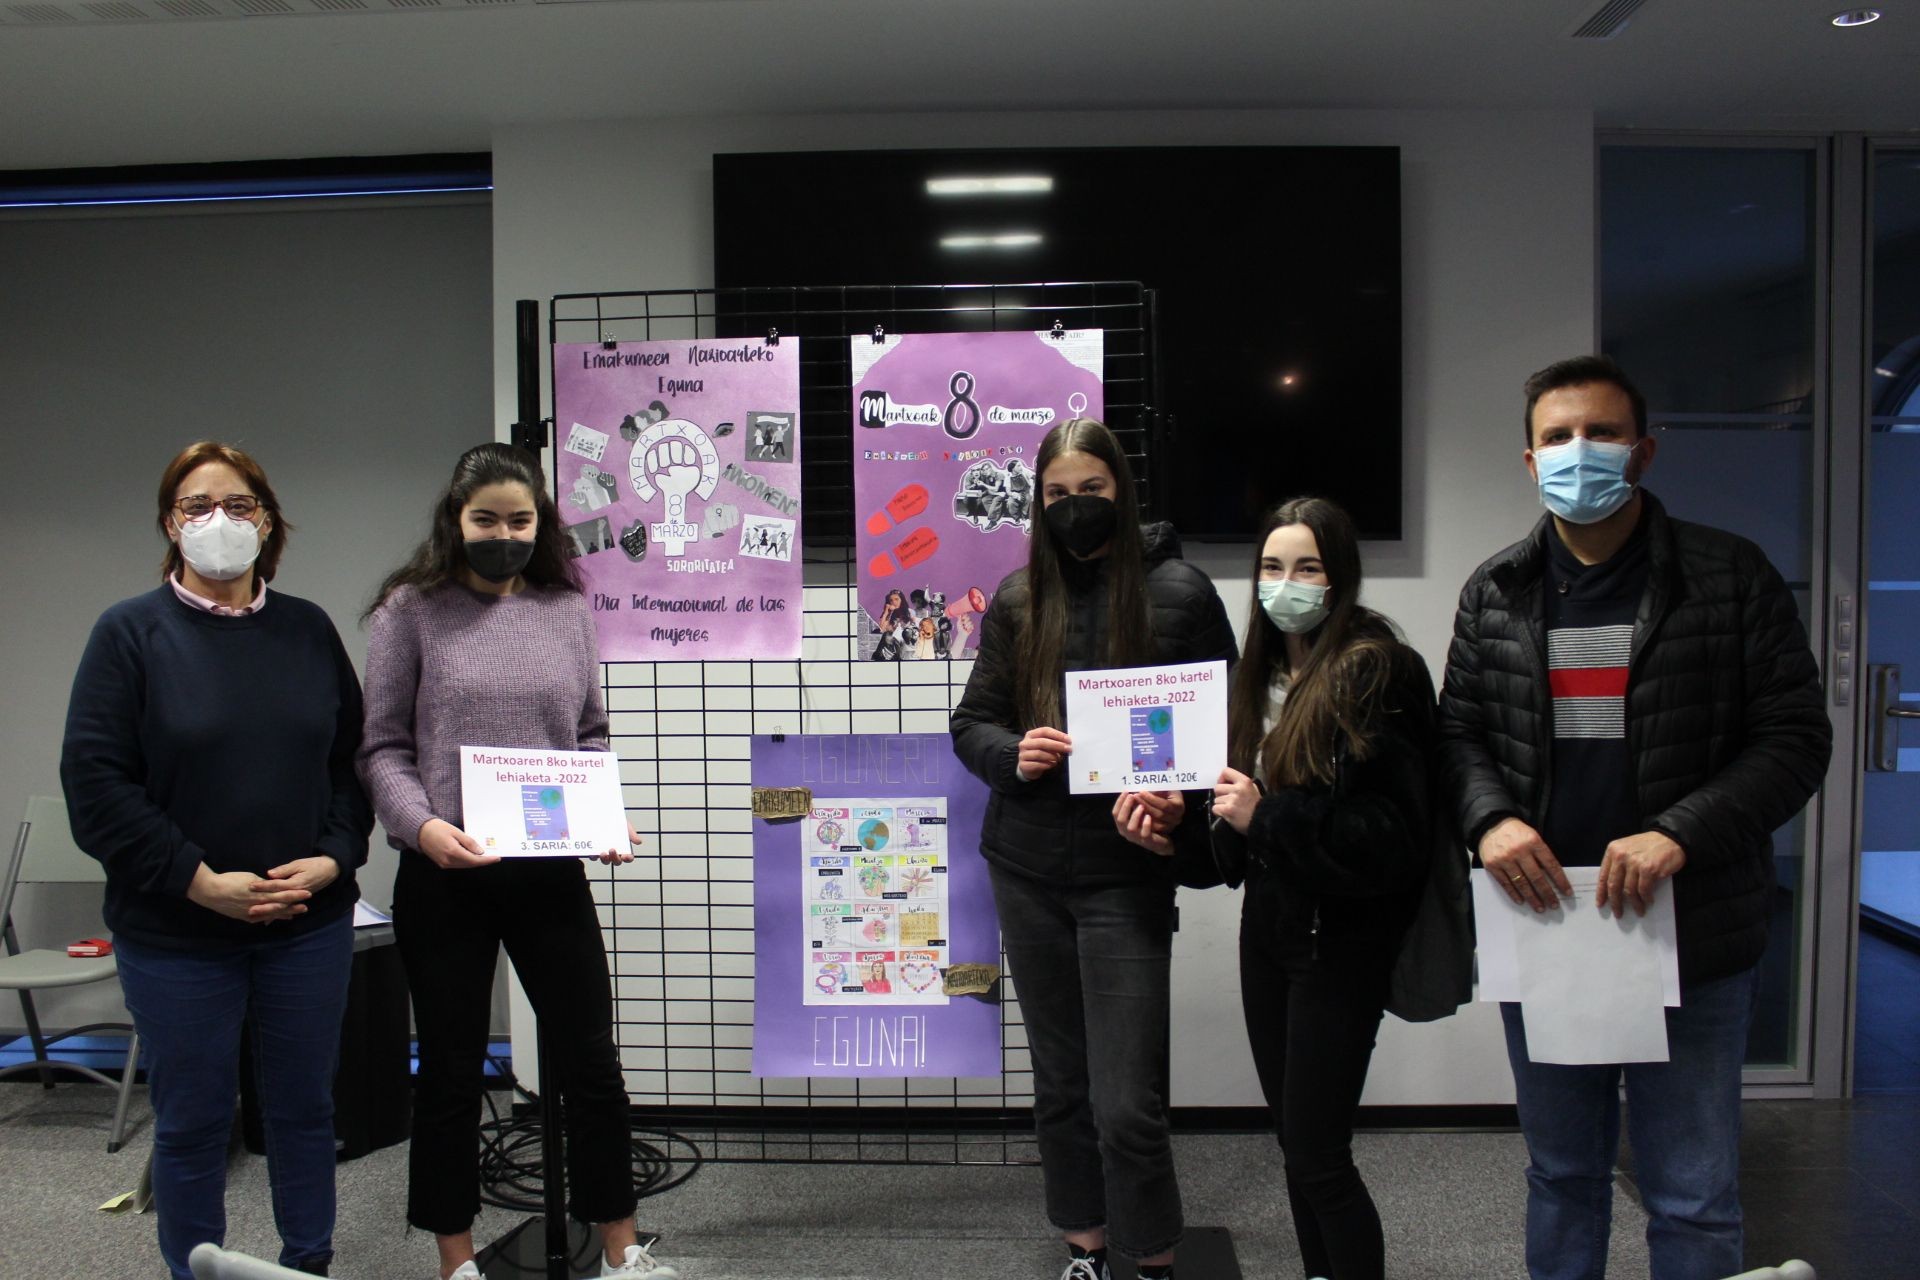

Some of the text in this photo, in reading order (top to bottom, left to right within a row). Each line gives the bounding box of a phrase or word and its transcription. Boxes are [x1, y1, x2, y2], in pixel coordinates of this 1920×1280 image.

[583, 344, 775, 369] Emakumeen Nazioarteko
[658, 376, 704, 397] Eguna
[860, 371, 1054, 440] Martxoak 8 de marzo
[669, 494, 683, 516] 8
[652, 525, 696, 538] MARZO
[666, 558, 735, 574] SORORITATEA
[736, 596, 754, 612] de
[760, 595, 785, 611] las
[1078, 669, 1213, 690] Martxoaren 8ko kartel
[1103, 690, 1196, 708] lehiaketa -2022
[473, 753, 605, 768] Martxoaren 8ko kartel
[496, 771, 588, 784] lehiaketa -2022
[1121, 772, 1198, 786] 1. SARIA: 120€
[521, 840, 593, 851] 3. SARIA: 60€
[813, 1015, 927, 1068] EGUNA!
